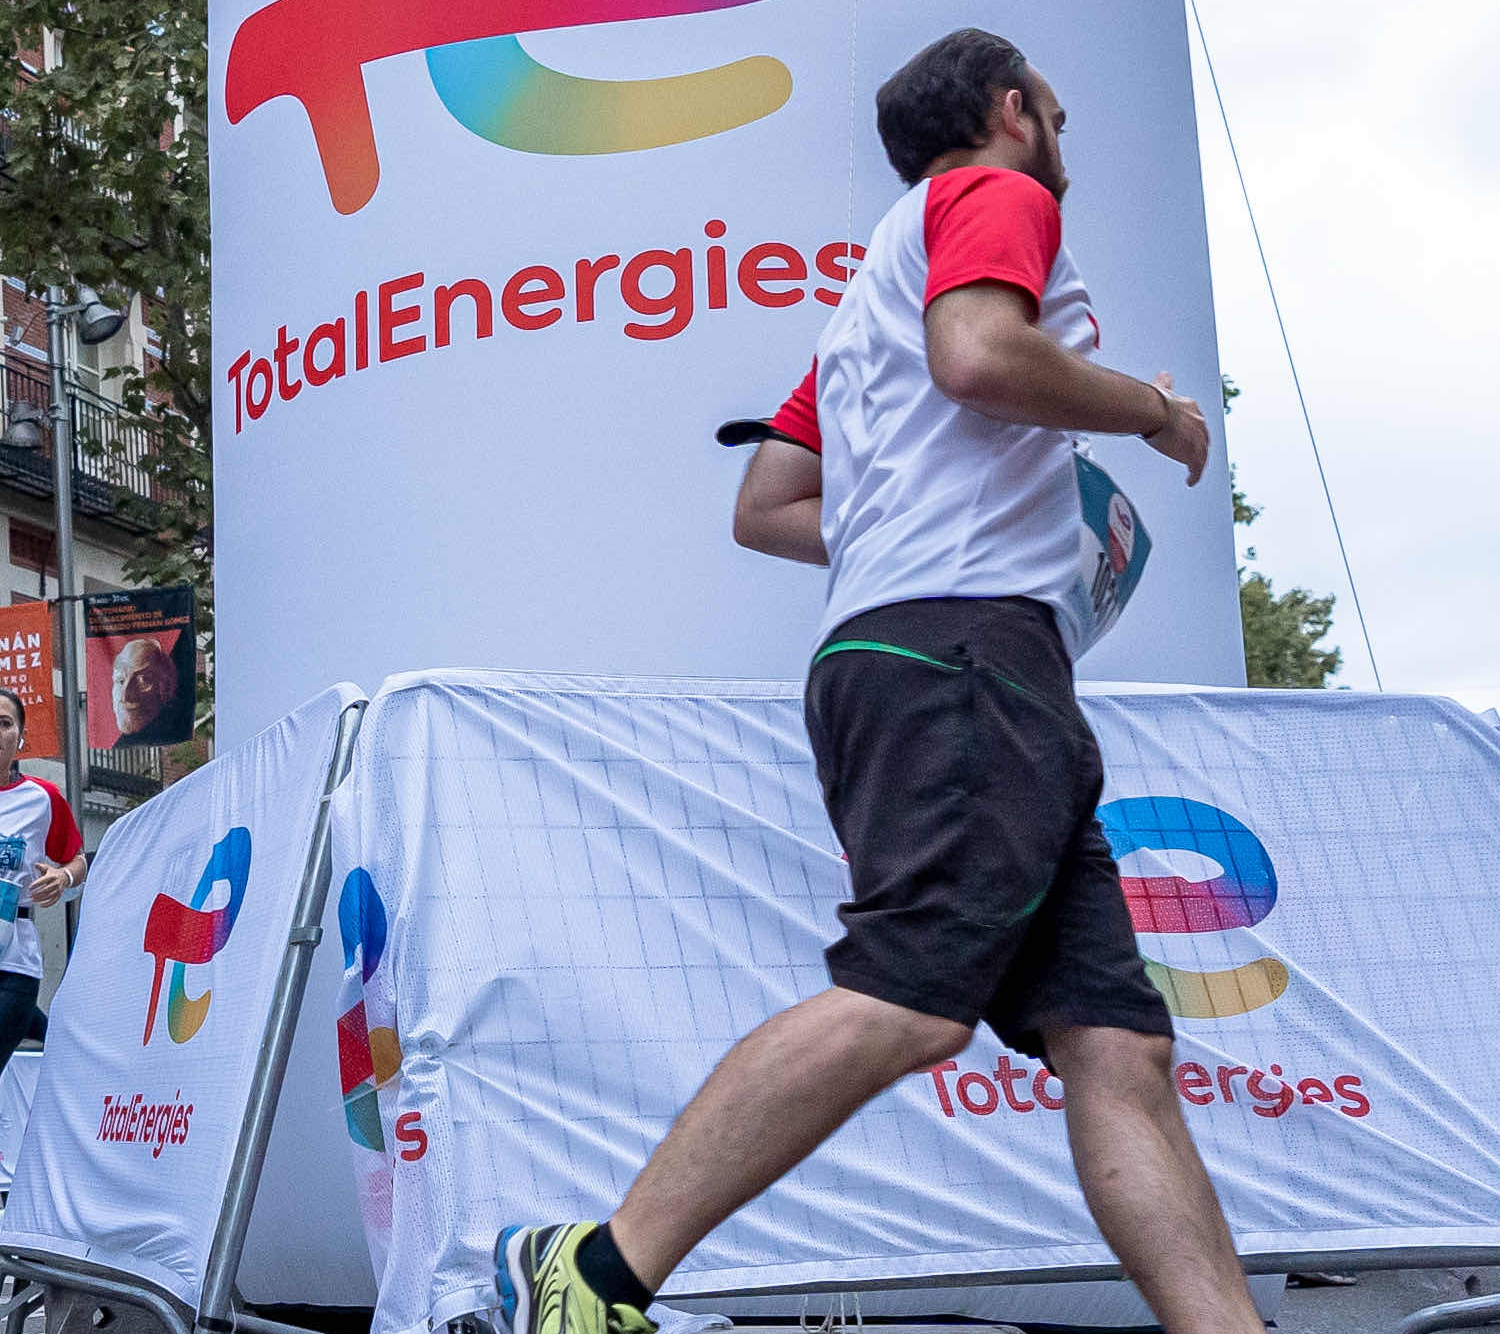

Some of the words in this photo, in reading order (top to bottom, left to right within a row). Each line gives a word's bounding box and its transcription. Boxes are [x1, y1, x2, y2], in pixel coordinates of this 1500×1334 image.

[228, 219, 867, 434] TotalEnergies
[21, 693, 44, 708] LLA
[926, 1054, 1371, 1119] Totaerges
[96, 1089, 194, 1160] TotalEnergies
